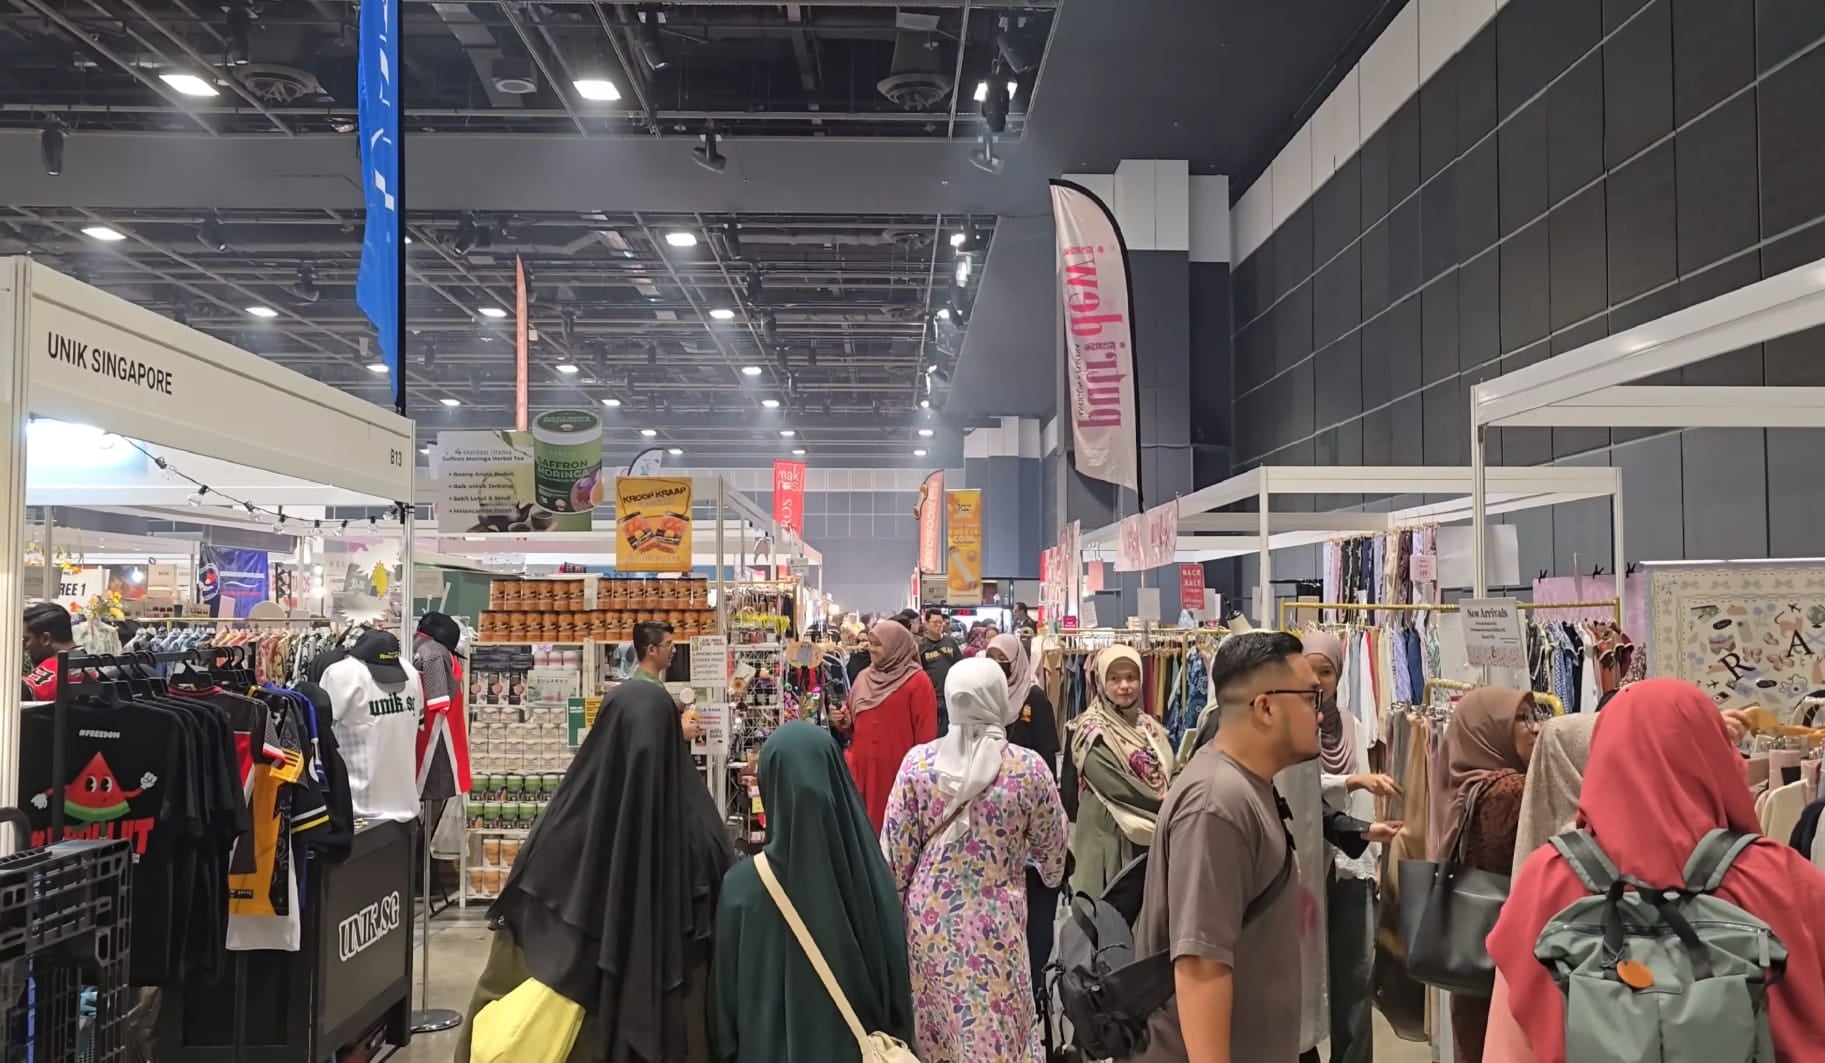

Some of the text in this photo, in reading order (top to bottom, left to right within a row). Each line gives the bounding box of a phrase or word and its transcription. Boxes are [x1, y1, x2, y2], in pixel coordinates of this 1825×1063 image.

[48, 332, 173, 395] UNIK SINGAPORE
[390, 448, 402, 467] B13
[537, 455, 588, 469] SAFFRON
[537, 465, 589, 479] MORINGA
[622, 492, 655, 504] KROOP
[59, 583, 87, 597] REE 1
[1467, 607, 1509, 618] New Arrivals
[1785, 629, 1815, 658] A
[1718, 652, 1757, 681] R
[78, 729, 121, 739] #FREEDOM
[339, 890, 400, 962] UNIK.SG
